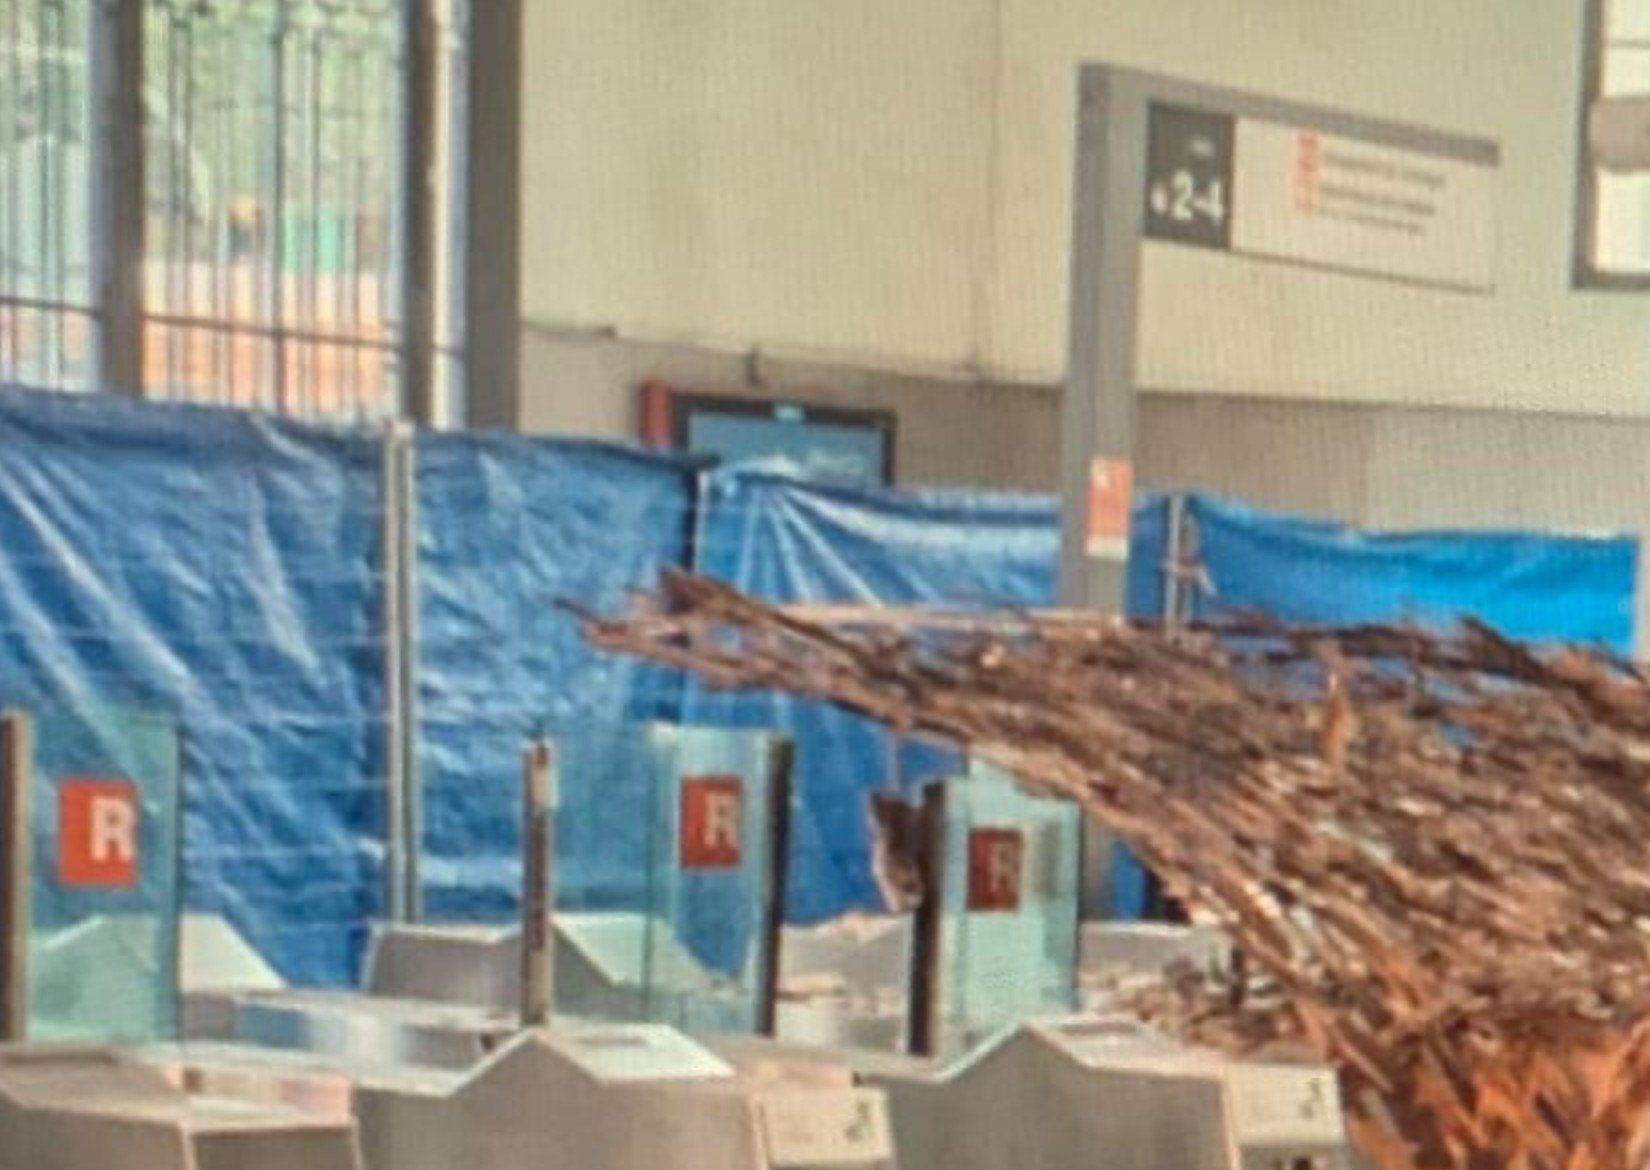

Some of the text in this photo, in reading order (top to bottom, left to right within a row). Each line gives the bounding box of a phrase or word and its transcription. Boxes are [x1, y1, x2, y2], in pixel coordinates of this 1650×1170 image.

[92, 796, 135, 861] R
[705, 792, 740, 849] R
[987, 842, 1019, 893] R
